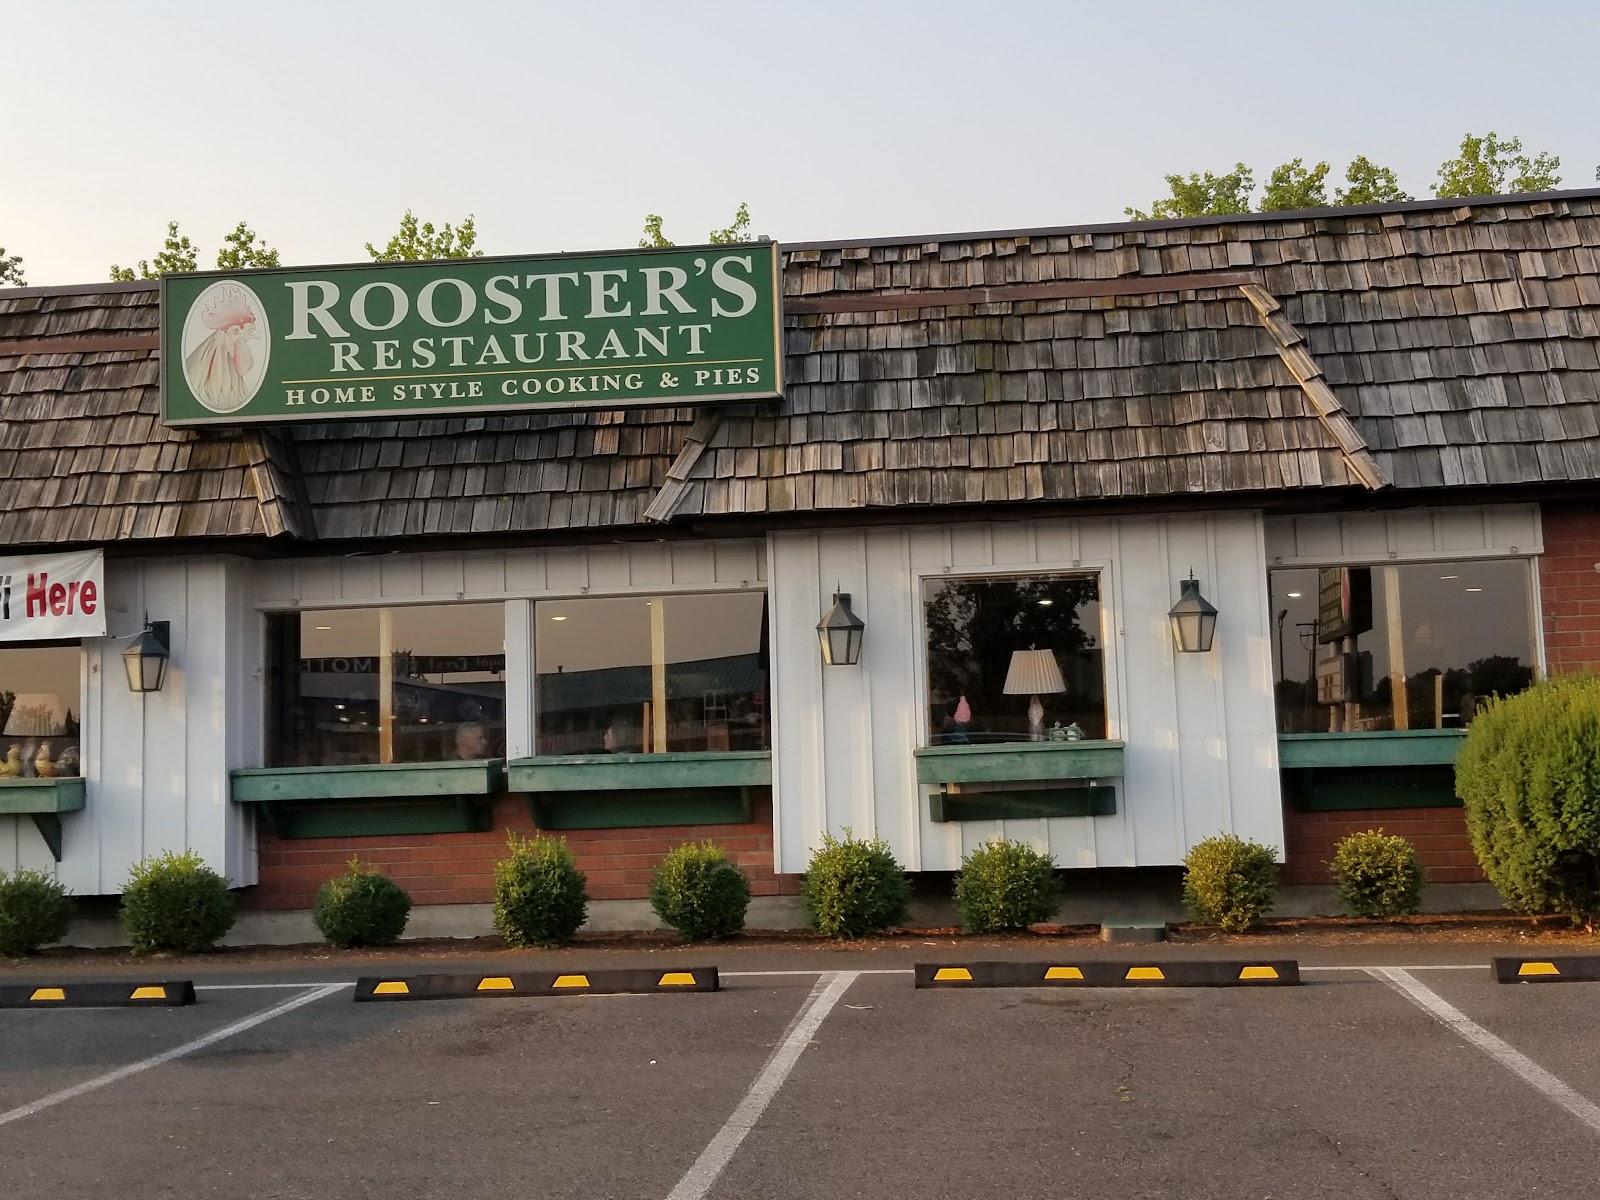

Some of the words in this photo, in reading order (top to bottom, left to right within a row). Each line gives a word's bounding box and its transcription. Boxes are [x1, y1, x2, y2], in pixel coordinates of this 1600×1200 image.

[284, 255, 757, 341] ROOSTER'S
[330, 323, 712, 372] RESTAURANT
[286, 386, 376, 406] HOME
[393, 381, 483, 401] STYLE
[501, 373, 644, 396] COOKING
[659, 371, 679, 389] &
[695, 367, 760, 387] PIES
[26, 572, 97, 618] Here
